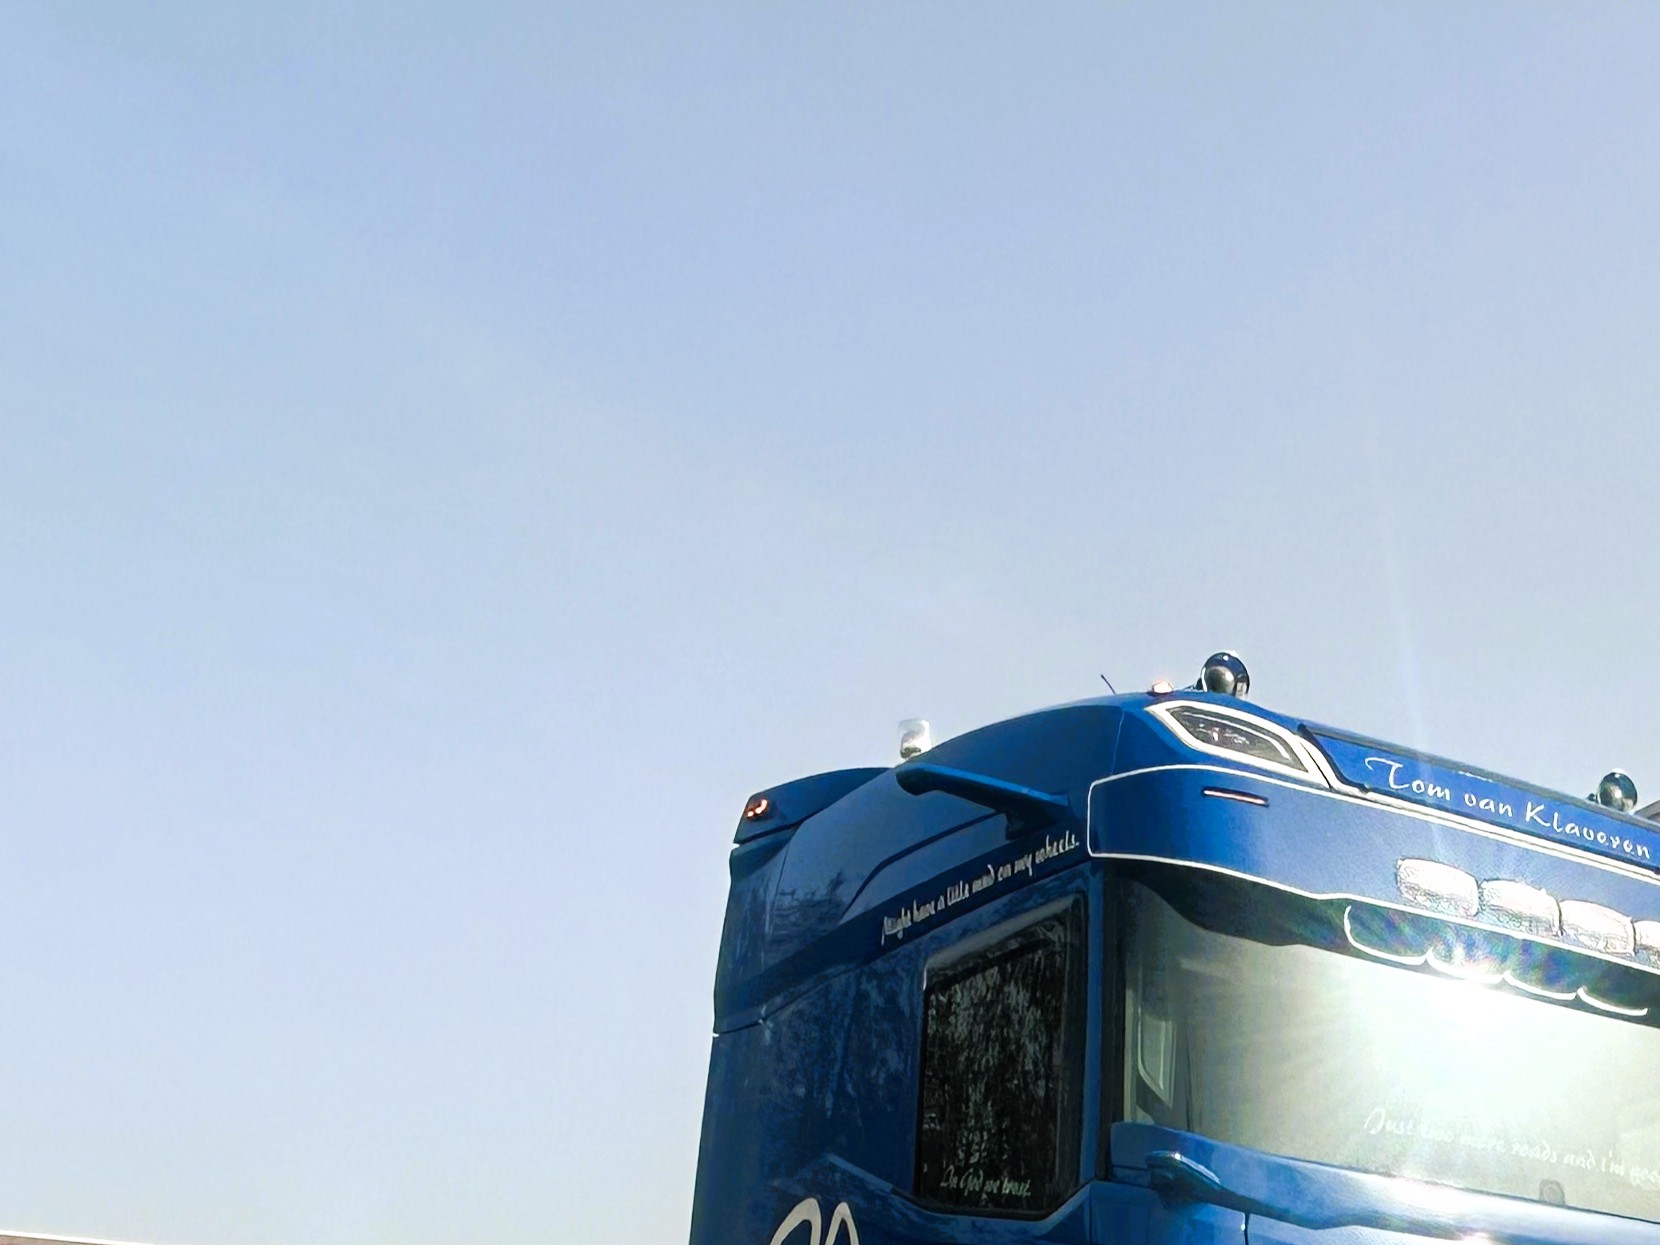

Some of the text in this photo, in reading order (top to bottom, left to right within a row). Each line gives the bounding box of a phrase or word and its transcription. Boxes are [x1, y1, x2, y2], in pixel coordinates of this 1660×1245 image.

[1364, 756, 1651, 860] Tom van Klaveren
